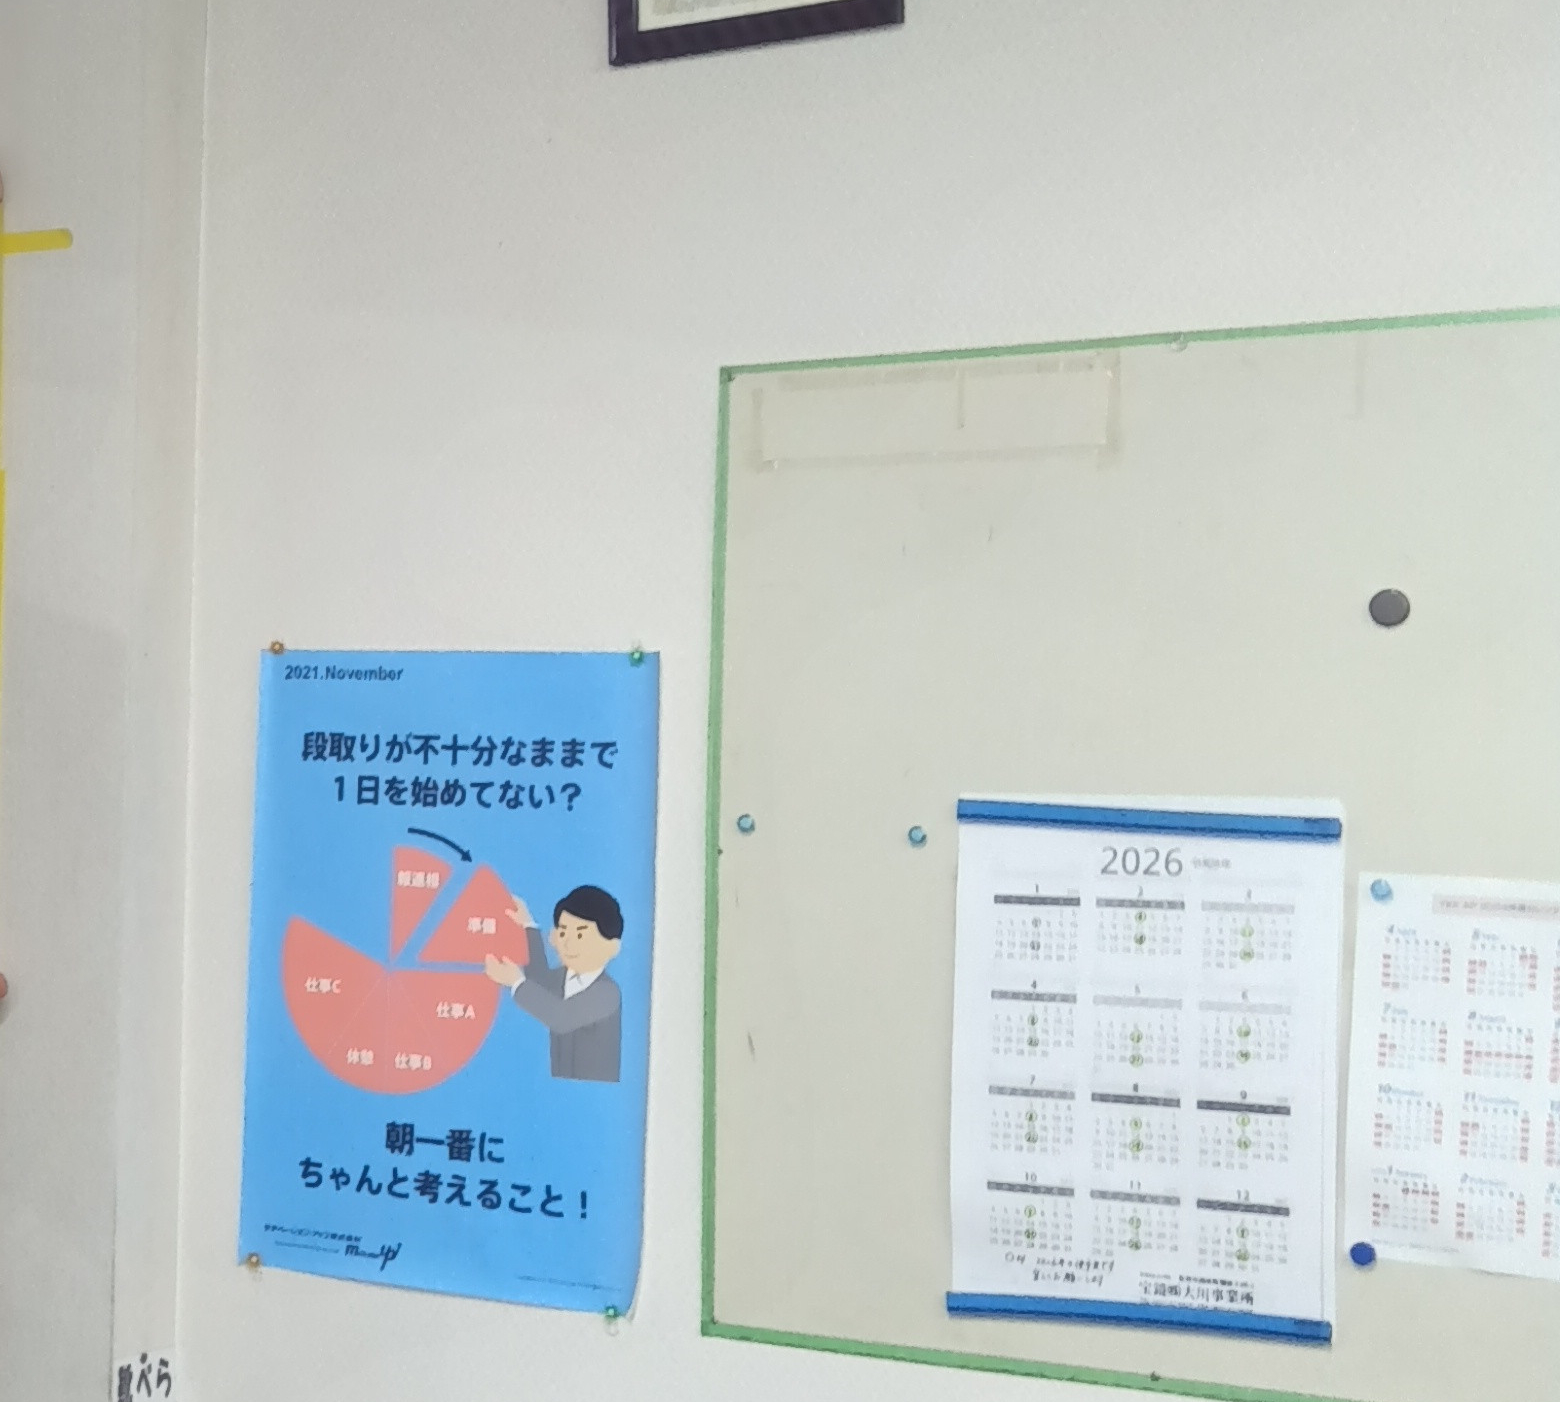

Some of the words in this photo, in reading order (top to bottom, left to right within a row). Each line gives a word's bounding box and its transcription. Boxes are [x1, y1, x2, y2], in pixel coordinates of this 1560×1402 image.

[284, 664, 404, 681] 2021.November
[301, 731, 619, 770] 段取りが不十分なままで
[334, 774, 582, 812] 1日を始めてない?
[1100, 846, 1183, 877] 2026
[435, 1001, 476, 1020] 仕事A
[385, 1121, 505, 1164] 朝一番に
[299, 1157, 588, 1220] ちゃんと考えること!
